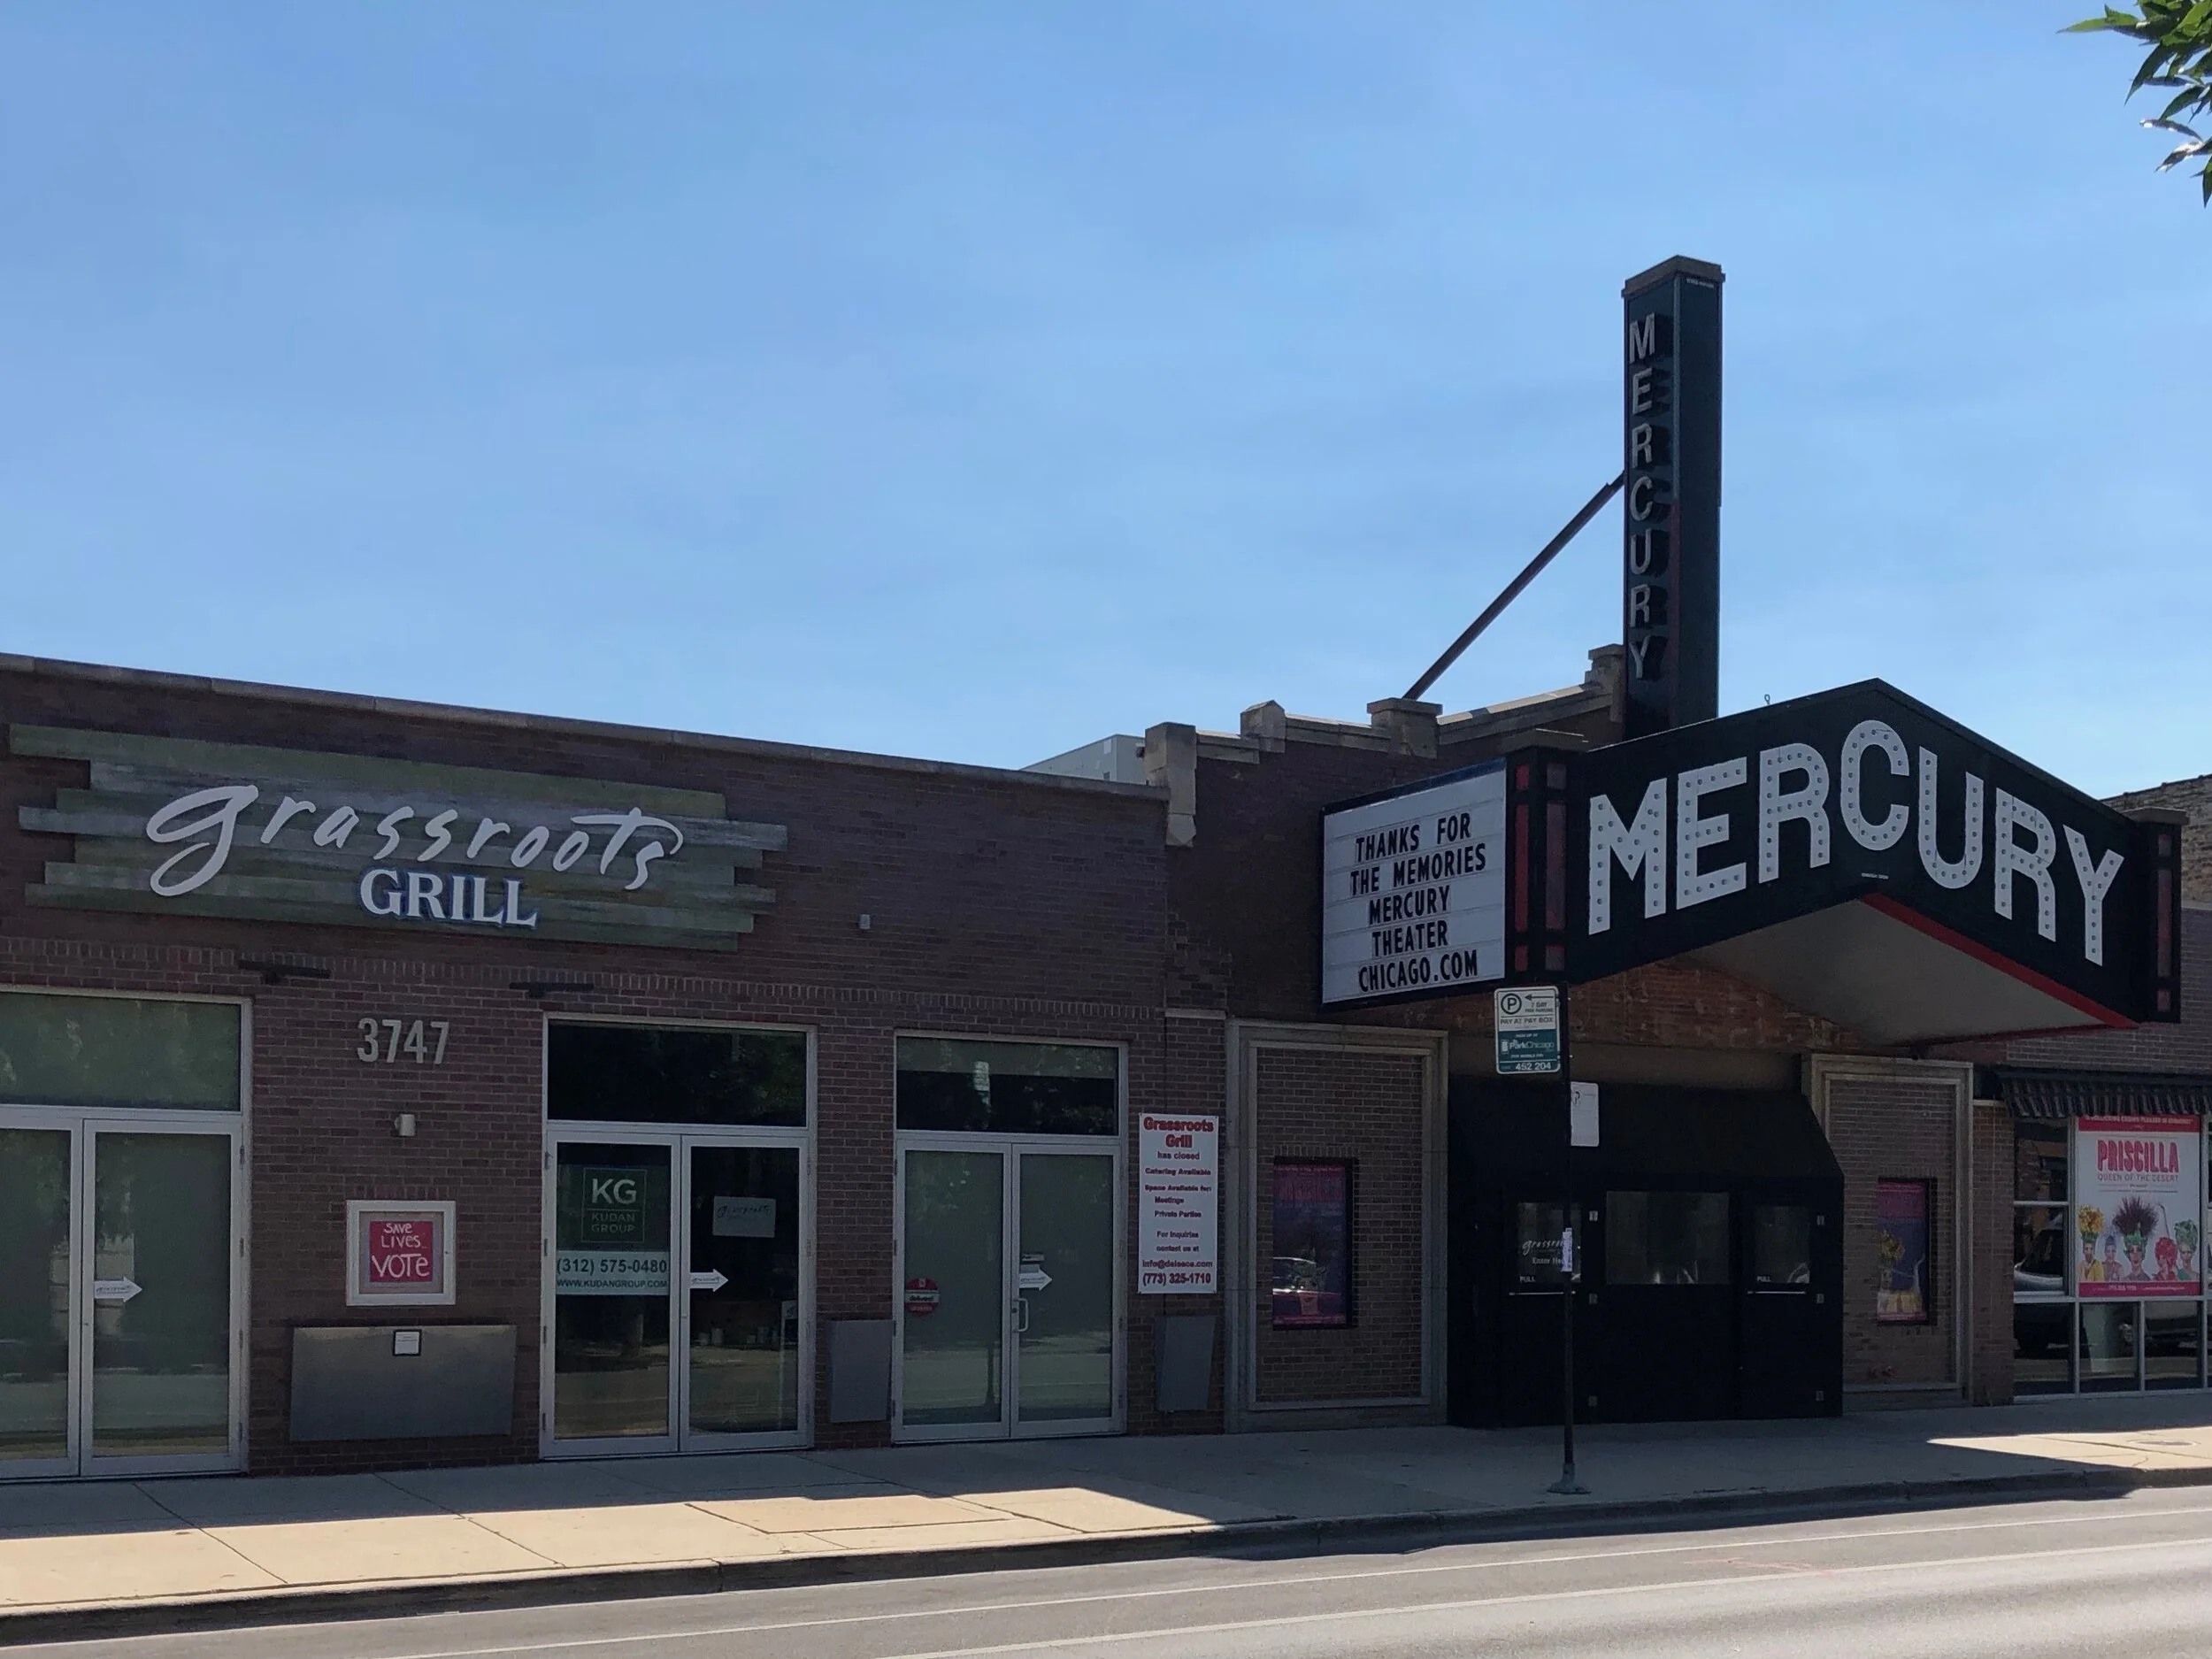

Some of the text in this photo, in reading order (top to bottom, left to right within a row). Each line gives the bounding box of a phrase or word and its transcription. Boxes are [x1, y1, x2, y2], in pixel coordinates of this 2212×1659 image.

[1629, 311, 1655, 680] MERCURY
[147, 784, 684, 896] grassroots
[1356, 812, 1471, 863] THANKS FOR
[1588, 719, 2124, 967] MERCURY
[1350, 842, 1486, 895] THE MEMORIES
[359, 868, 537, 928] GRILL
[1369, 885, 1450, 925] MERCURY
[1372, 919, 1448, 956] THEATER
[1358, 949, 1478, 992] CHICAGO.COM
[357, 1018, 449, 1064] 3747
[1509, 1041, 1555, 1049] ParkChicago
[1143, 1116, 1214, 1133] Grassroots
[1165, 1133, 1193, 1148] Grill
[1174, 1151, 1200, 1160] closed
[2097, 1140, 2179, 1173] PRISCILLA
[1145, 1167, 1176, 1176] Catering
[591, 1178, 637, 1204] KG
[591, 1212, 635, 1222] KUDAN
[591, 1224, 636, 1233] GROUP
[557, 1258, 667, 1276] (312) 575-0480
[1142, 1272, 1211, 1286] (773) 325-1710
[557, 1279, 668, 1288] WWW.KUDANGROUP.COM
